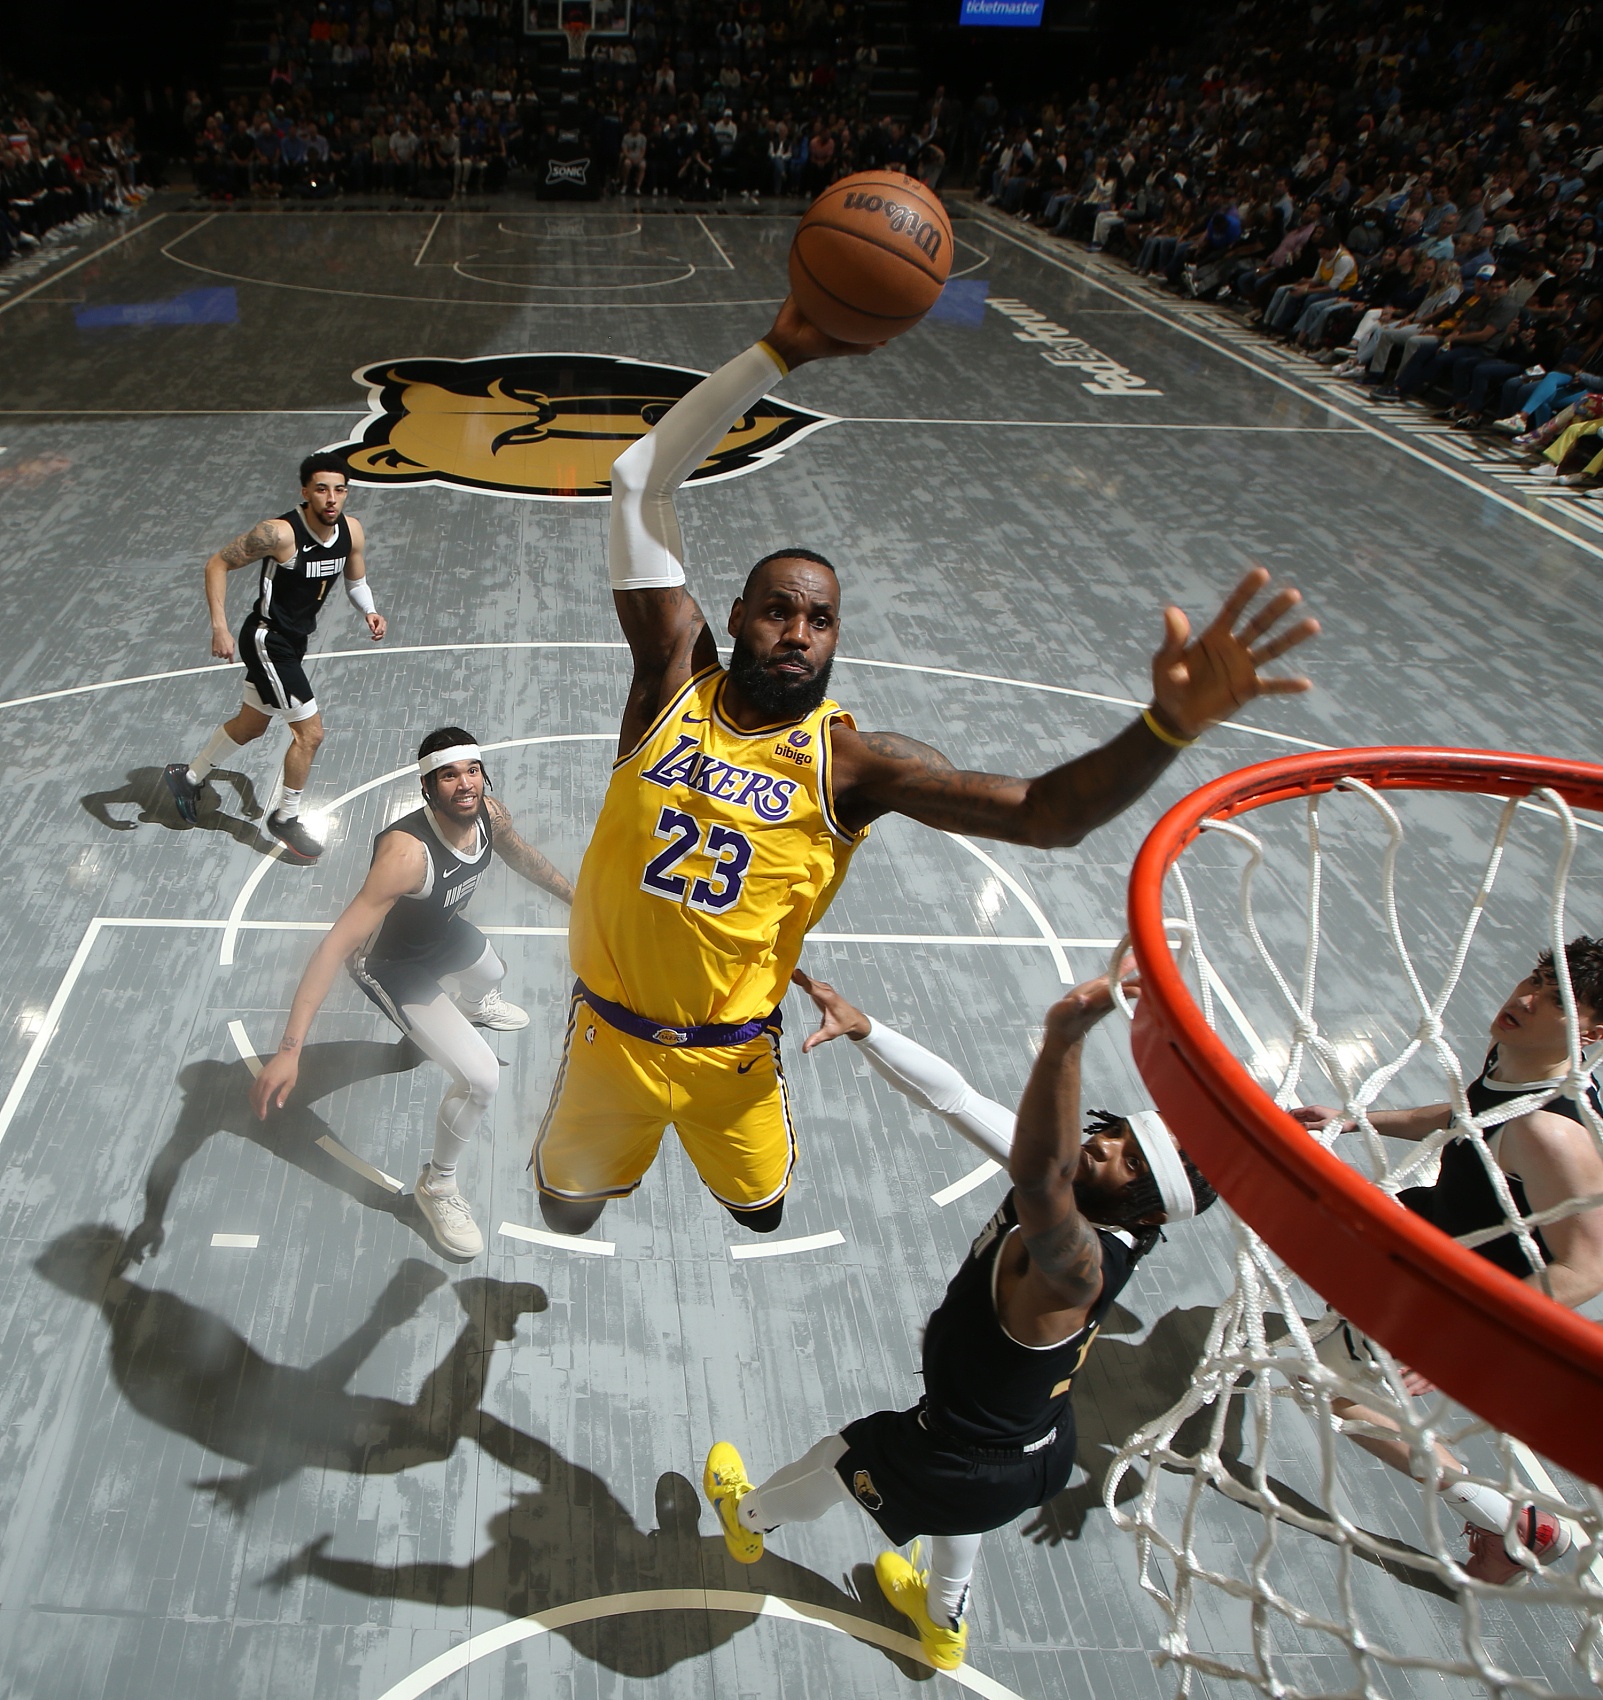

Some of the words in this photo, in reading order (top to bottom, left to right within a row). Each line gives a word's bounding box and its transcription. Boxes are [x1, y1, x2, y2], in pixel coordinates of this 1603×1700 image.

[967, 0, 1039, 14] ticketmaster
[552, 167, 583, 176] SONIC
[844, 191, 942, 264] Wilson
[317, 580, 327, 600] 1
[775, 745, 812, 765] bibigo
[640, 734, 800, 823] LAKERS
[640, 805, 755, 915] 23
